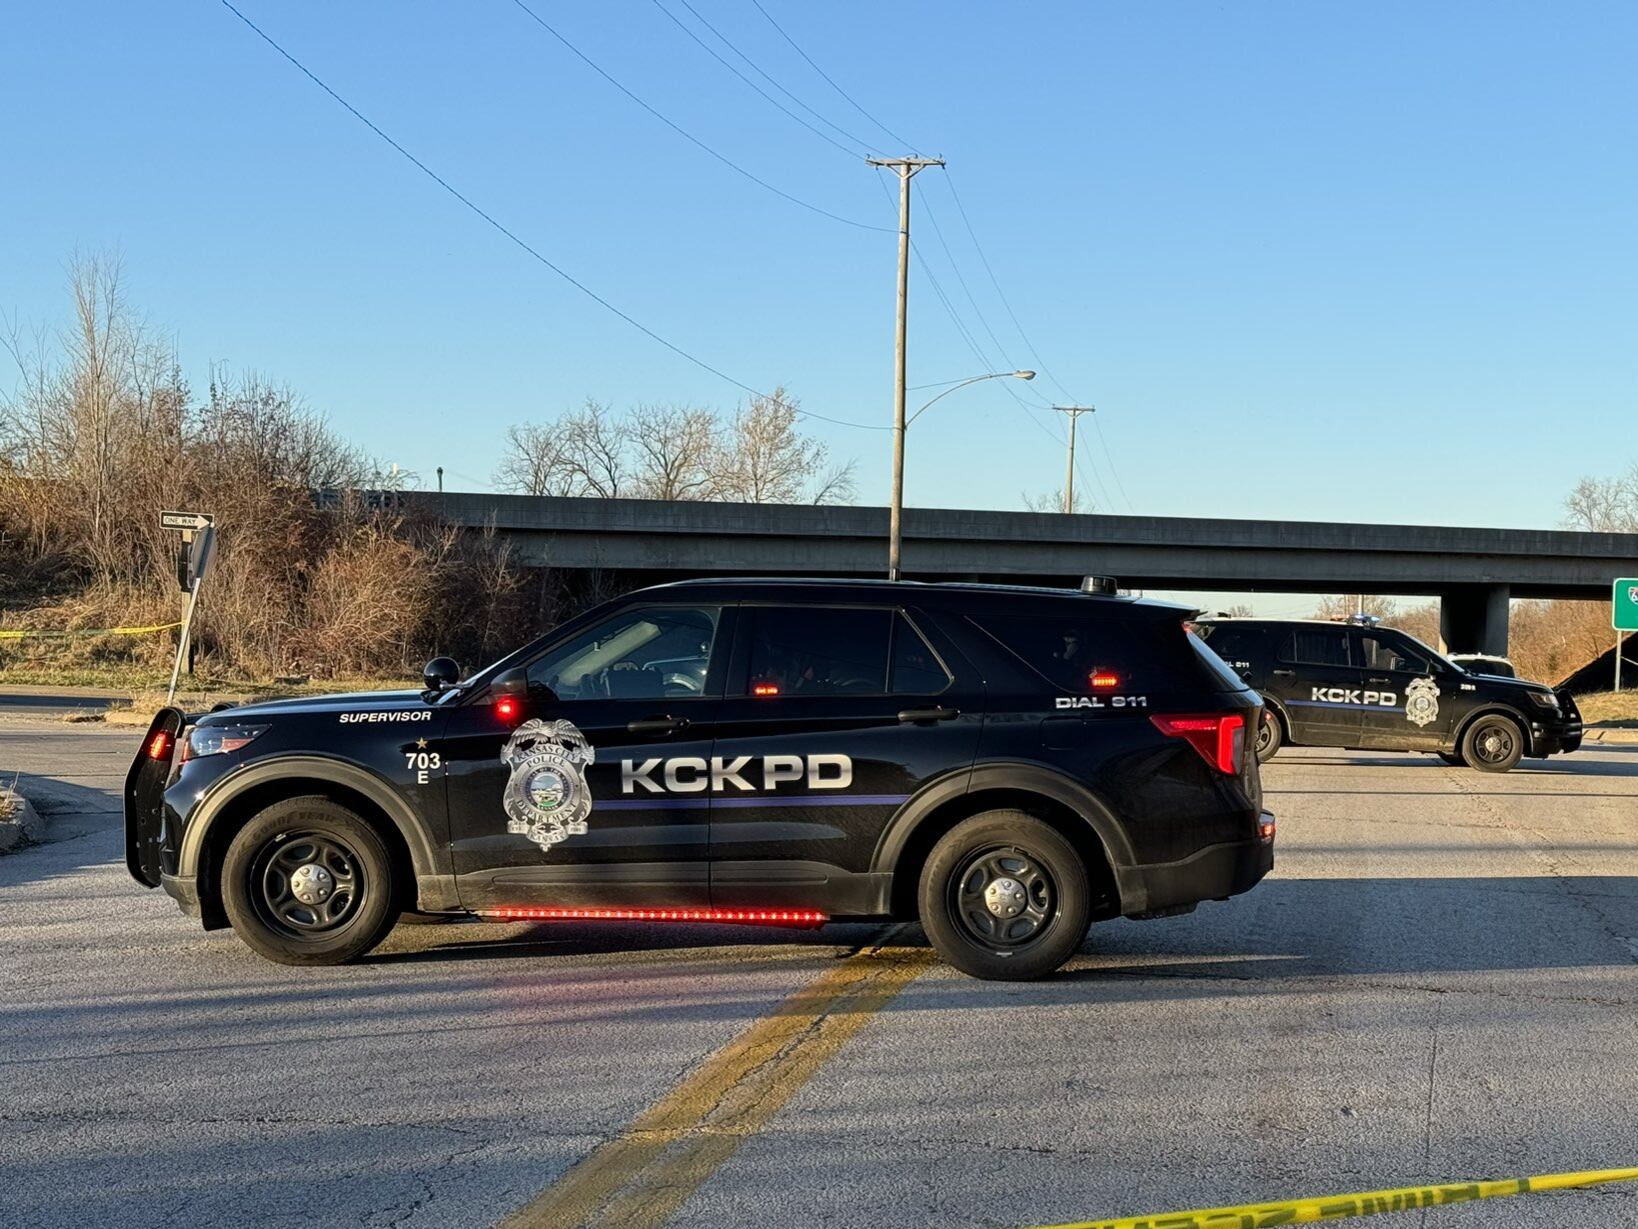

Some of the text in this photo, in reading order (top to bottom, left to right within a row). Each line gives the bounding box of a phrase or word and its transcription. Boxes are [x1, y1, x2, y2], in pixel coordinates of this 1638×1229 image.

[165, 517, 180, 525] ONE
[1055, 696, 1147, 709] DIAL 911
[1311, 687, 1398, 706] KCKPD
[339, 711, 432, 724] SUPERVISOR
[405, 752, 441, 770] 703
[517, 745, 577, 762] KANSAS CITY
[526, 755, 565, 768] POLICE
[417, 770, 429, 785] E
[621, 753, 853, 794] KCKPD
[516, 799, 577, 824] DEPARTMENT
